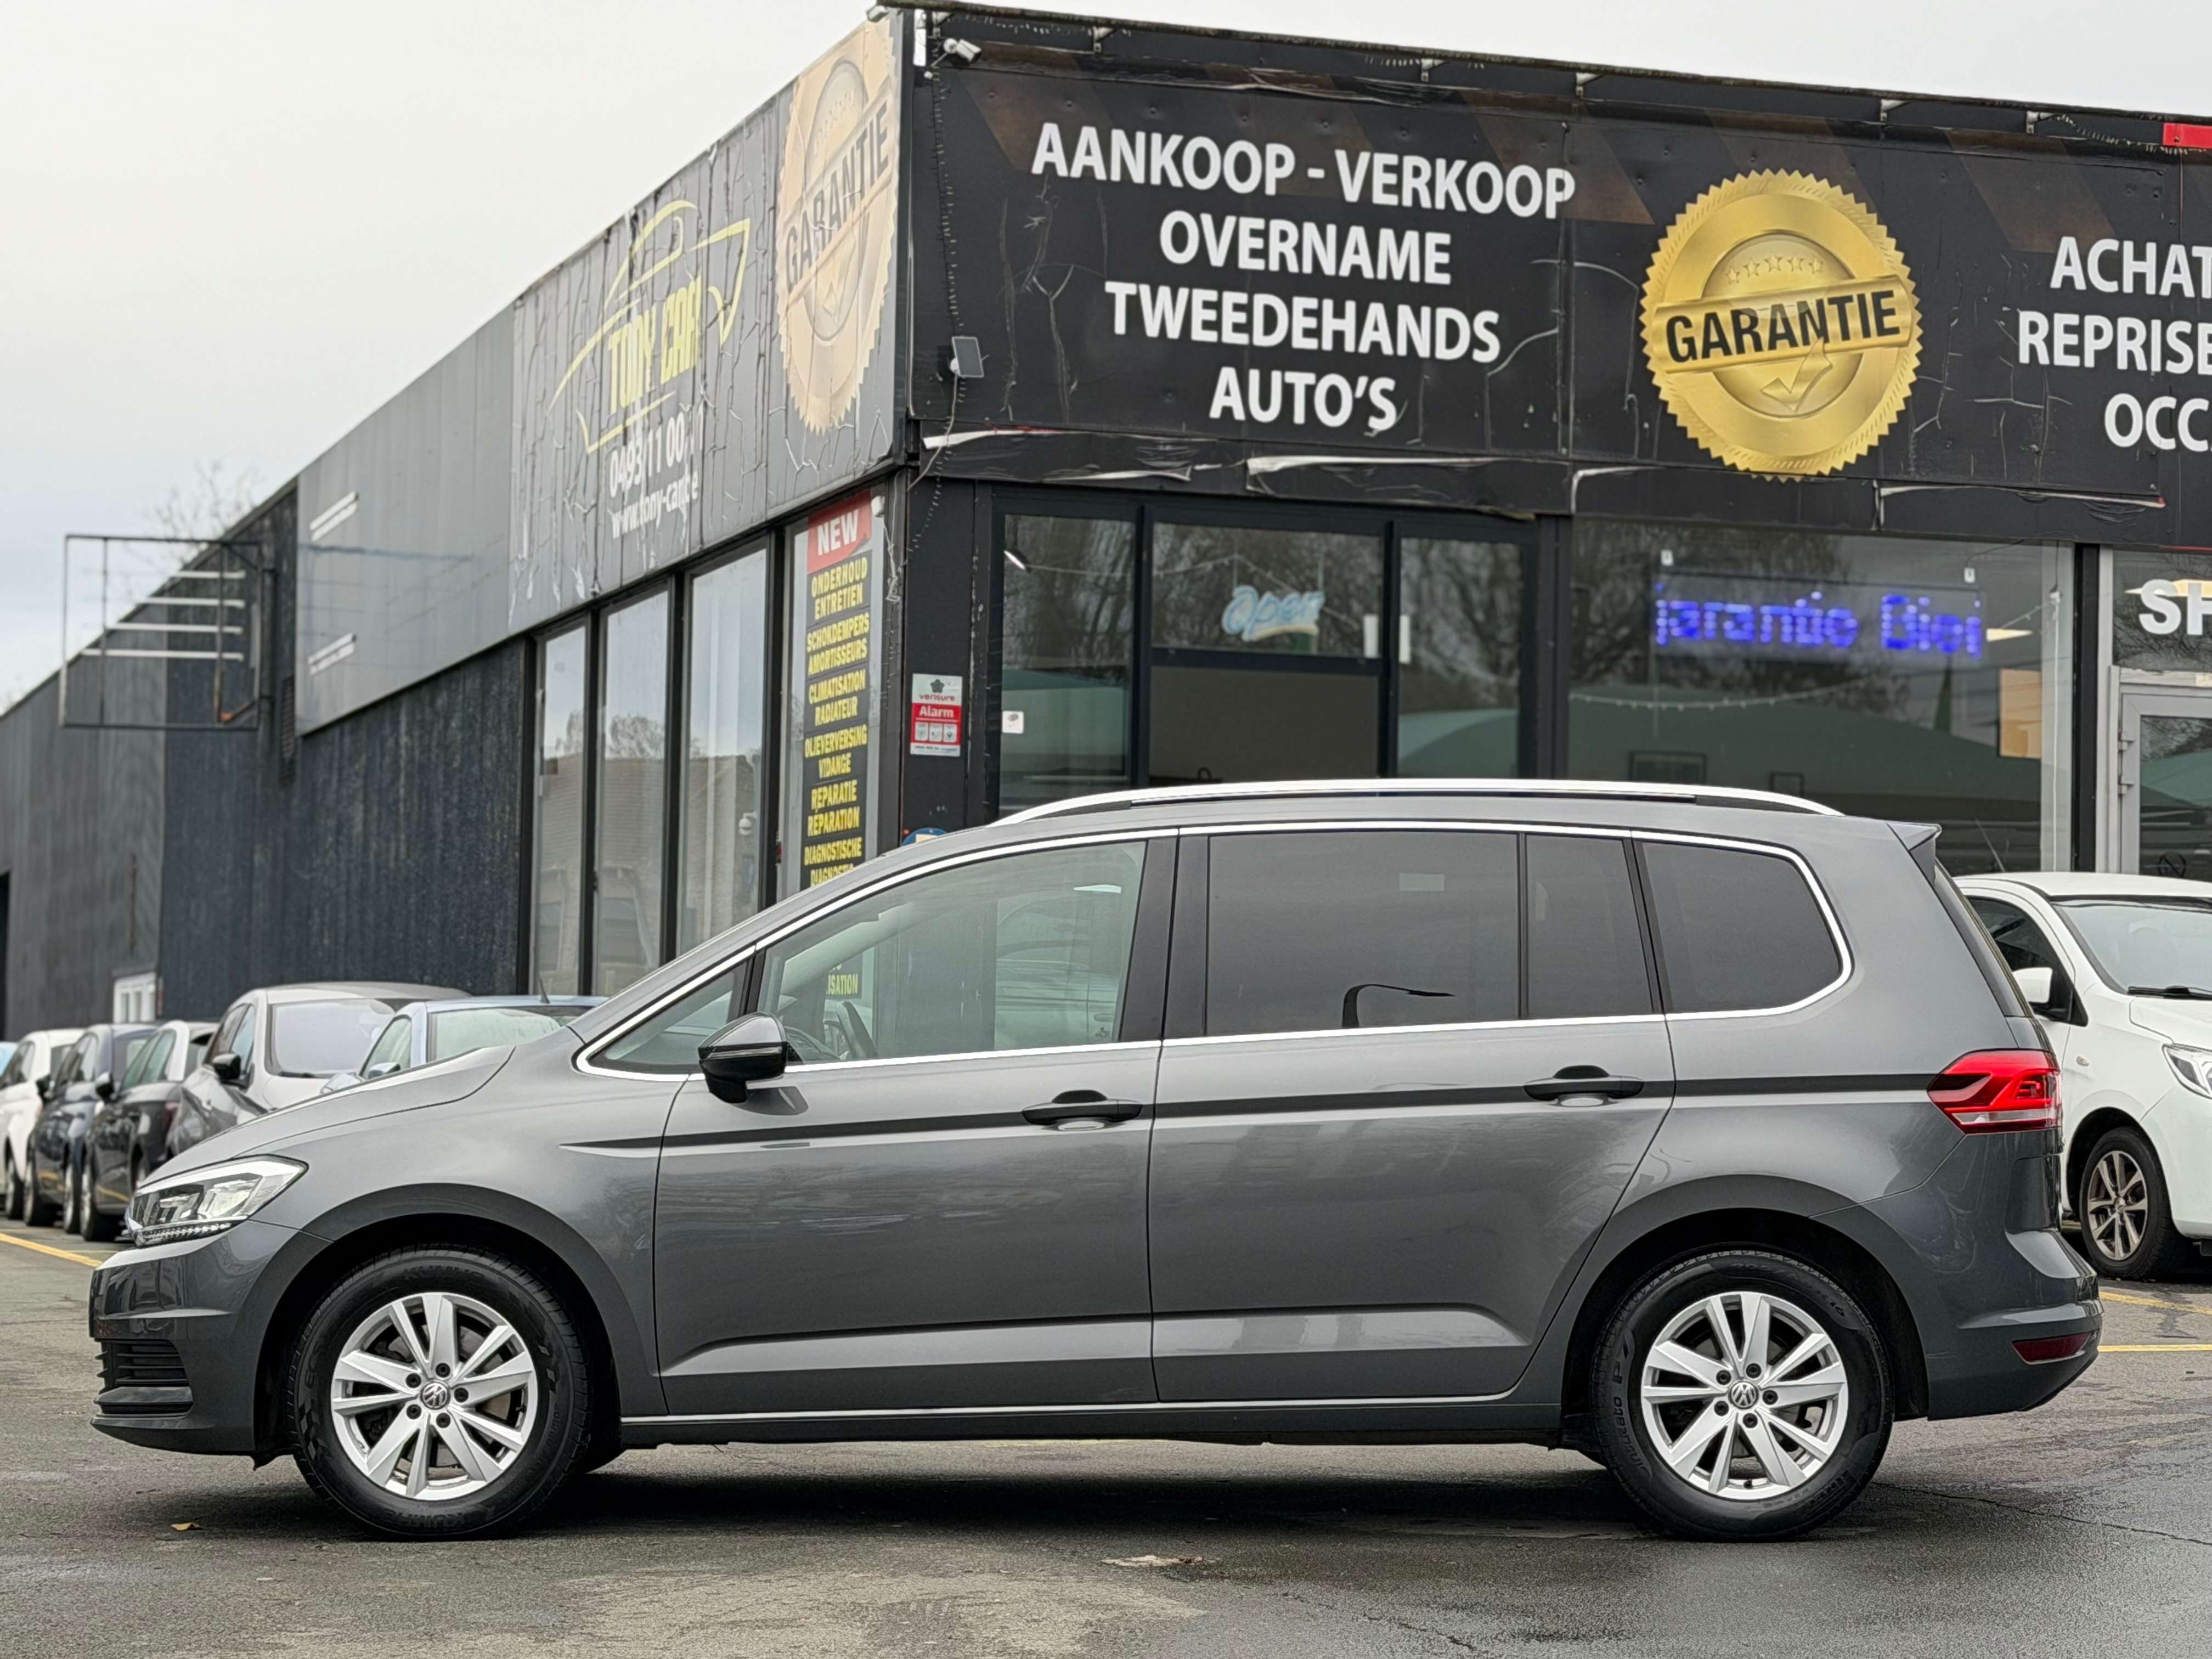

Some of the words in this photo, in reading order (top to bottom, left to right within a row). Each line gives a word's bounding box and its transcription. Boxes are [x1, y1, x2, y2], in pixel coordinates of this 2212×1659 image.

[1032, 122, 1295, 196] AANKOOP
[1335, 149, 1576, 219] VERKOOP
[786, 99, 889, 290] GARANTIE
[1160, 210, 1452, 285] OVERNAME
[1105, 281, 1500, 363] TWEEDEHANDS
[1666, 289, 1901, 363] GARANTIE
[1209, 366, 1397, 431] AUTO'S
[2104, 393, 2212, 452] OCC
[817, 509, 859, 556] NEW
[811, 557, 868, 598] ONDERHOUD
[815, 583, 864, 620] ENTRETIEN
[1222, 585, 1325, 641] Open
[1655, 582, 1859, 647] arantie
[806, 612, 870, 653] SCHOKDEMPERS
[808, 637, 867, 676] AMORTISSEURS
[808, 668, 866, 705] CLIMATISATION
[919, 693, 956, 702] verisure
[815, 696, 858, 726] RADIATEUR
[919, 705, 954, 718] Alarm
[804, 724, 868, 758] OLIEVERVERSING
[818, 752, 851, 779] VIDANGE
[811, 779, 857, 810] REPARATIE
[804, 837, 862, 866] DIAGNOSTISCHE
[810, 863, 854, 886] DIAGNOS
[826, 973, 858, 995] ISATION
